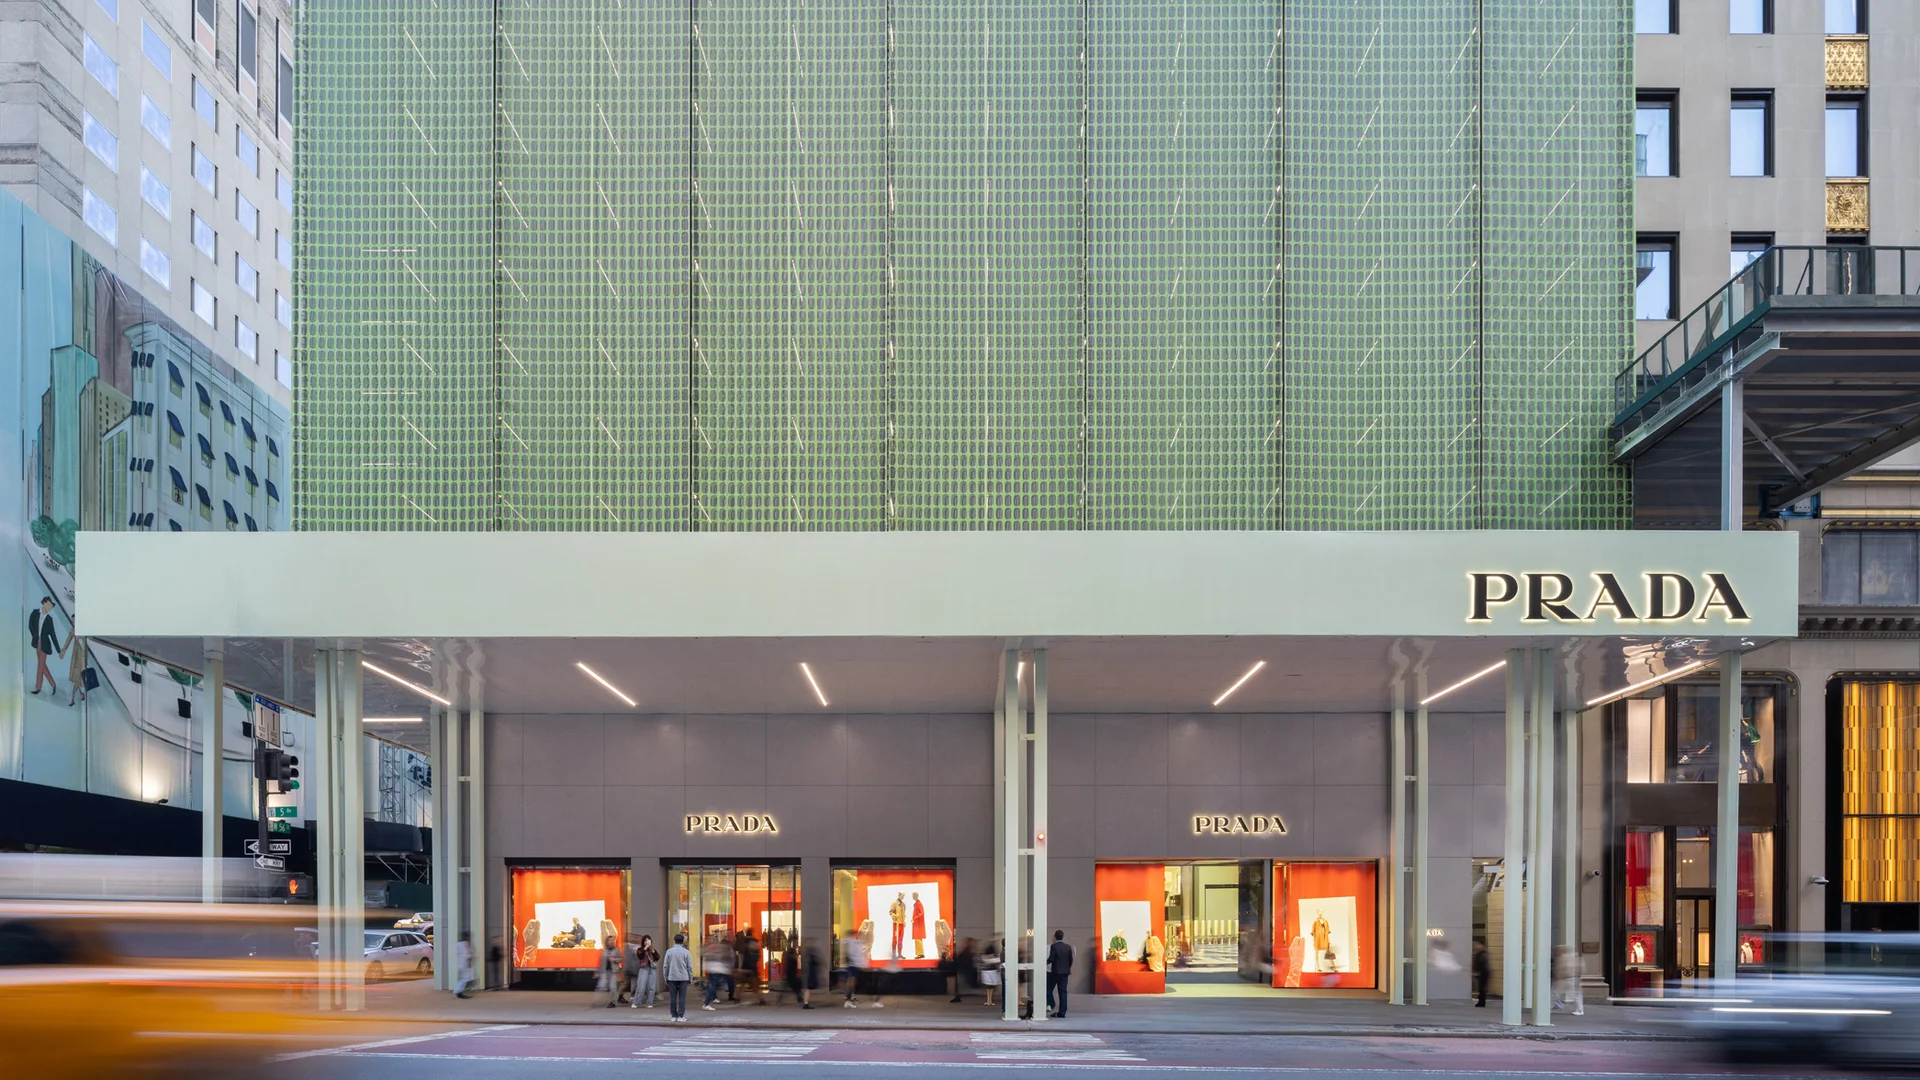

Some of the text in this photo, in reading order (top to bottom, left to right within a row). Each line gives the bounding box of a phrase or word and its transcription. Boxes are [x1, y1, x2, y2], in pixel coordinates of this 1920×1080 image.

[1467, 573, 1751, 620] PRADA
[280, 807, 285, 817] 5
[279, 823, 286, 832] 56
[685, 815, 778, 832] PRADA
[1194, 816, 1287, 833] PRADA
